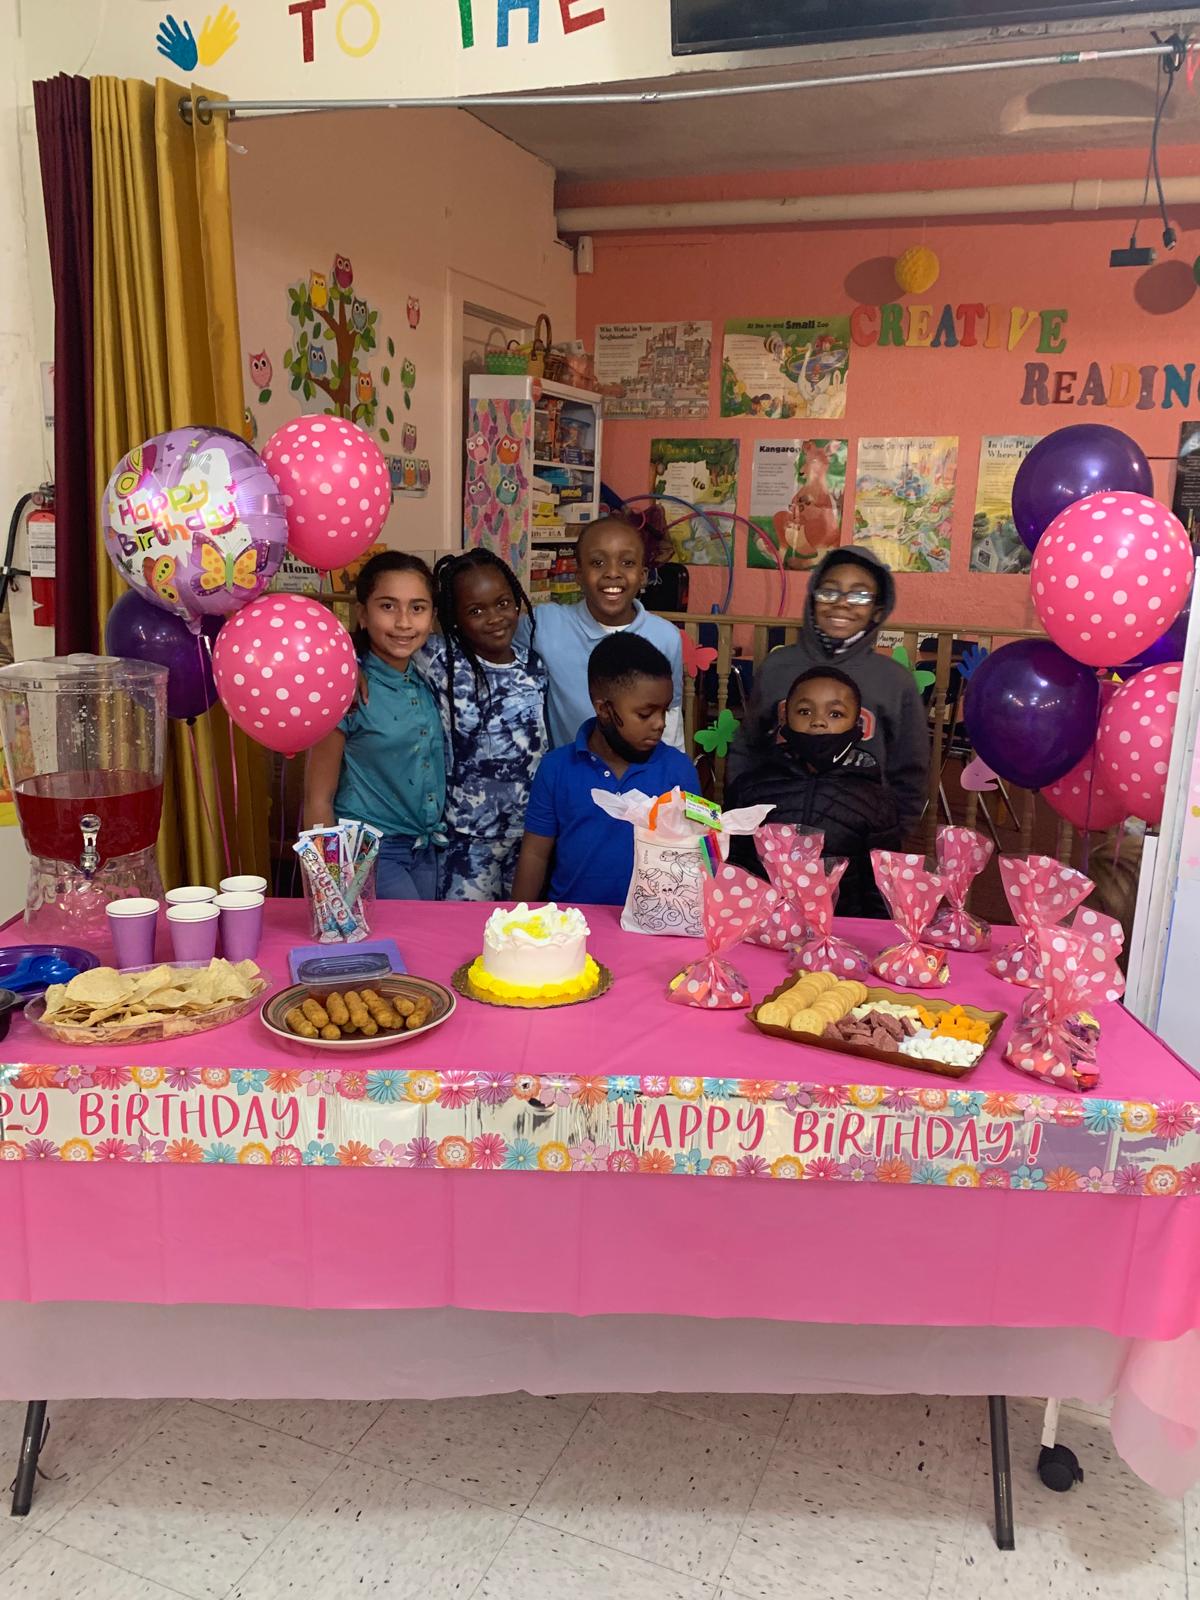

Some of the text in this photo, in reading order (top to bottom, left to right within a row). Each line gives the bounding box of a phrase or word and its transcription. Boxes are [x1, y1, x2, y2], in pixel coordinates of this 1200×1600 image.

[288, 0, 381, 63] TO
[785, 320, 815, 329] Small
[850, 303, 1067, 353] CREATIVE
[1020, 361, 1200, 410] READIN
[1016, 440, 1035, 449] Pla
[118, 480, 209, 526] Happy
[117, 501, 239, 557] Birthday
[610, 1103, 765, 1152] HAPPY
